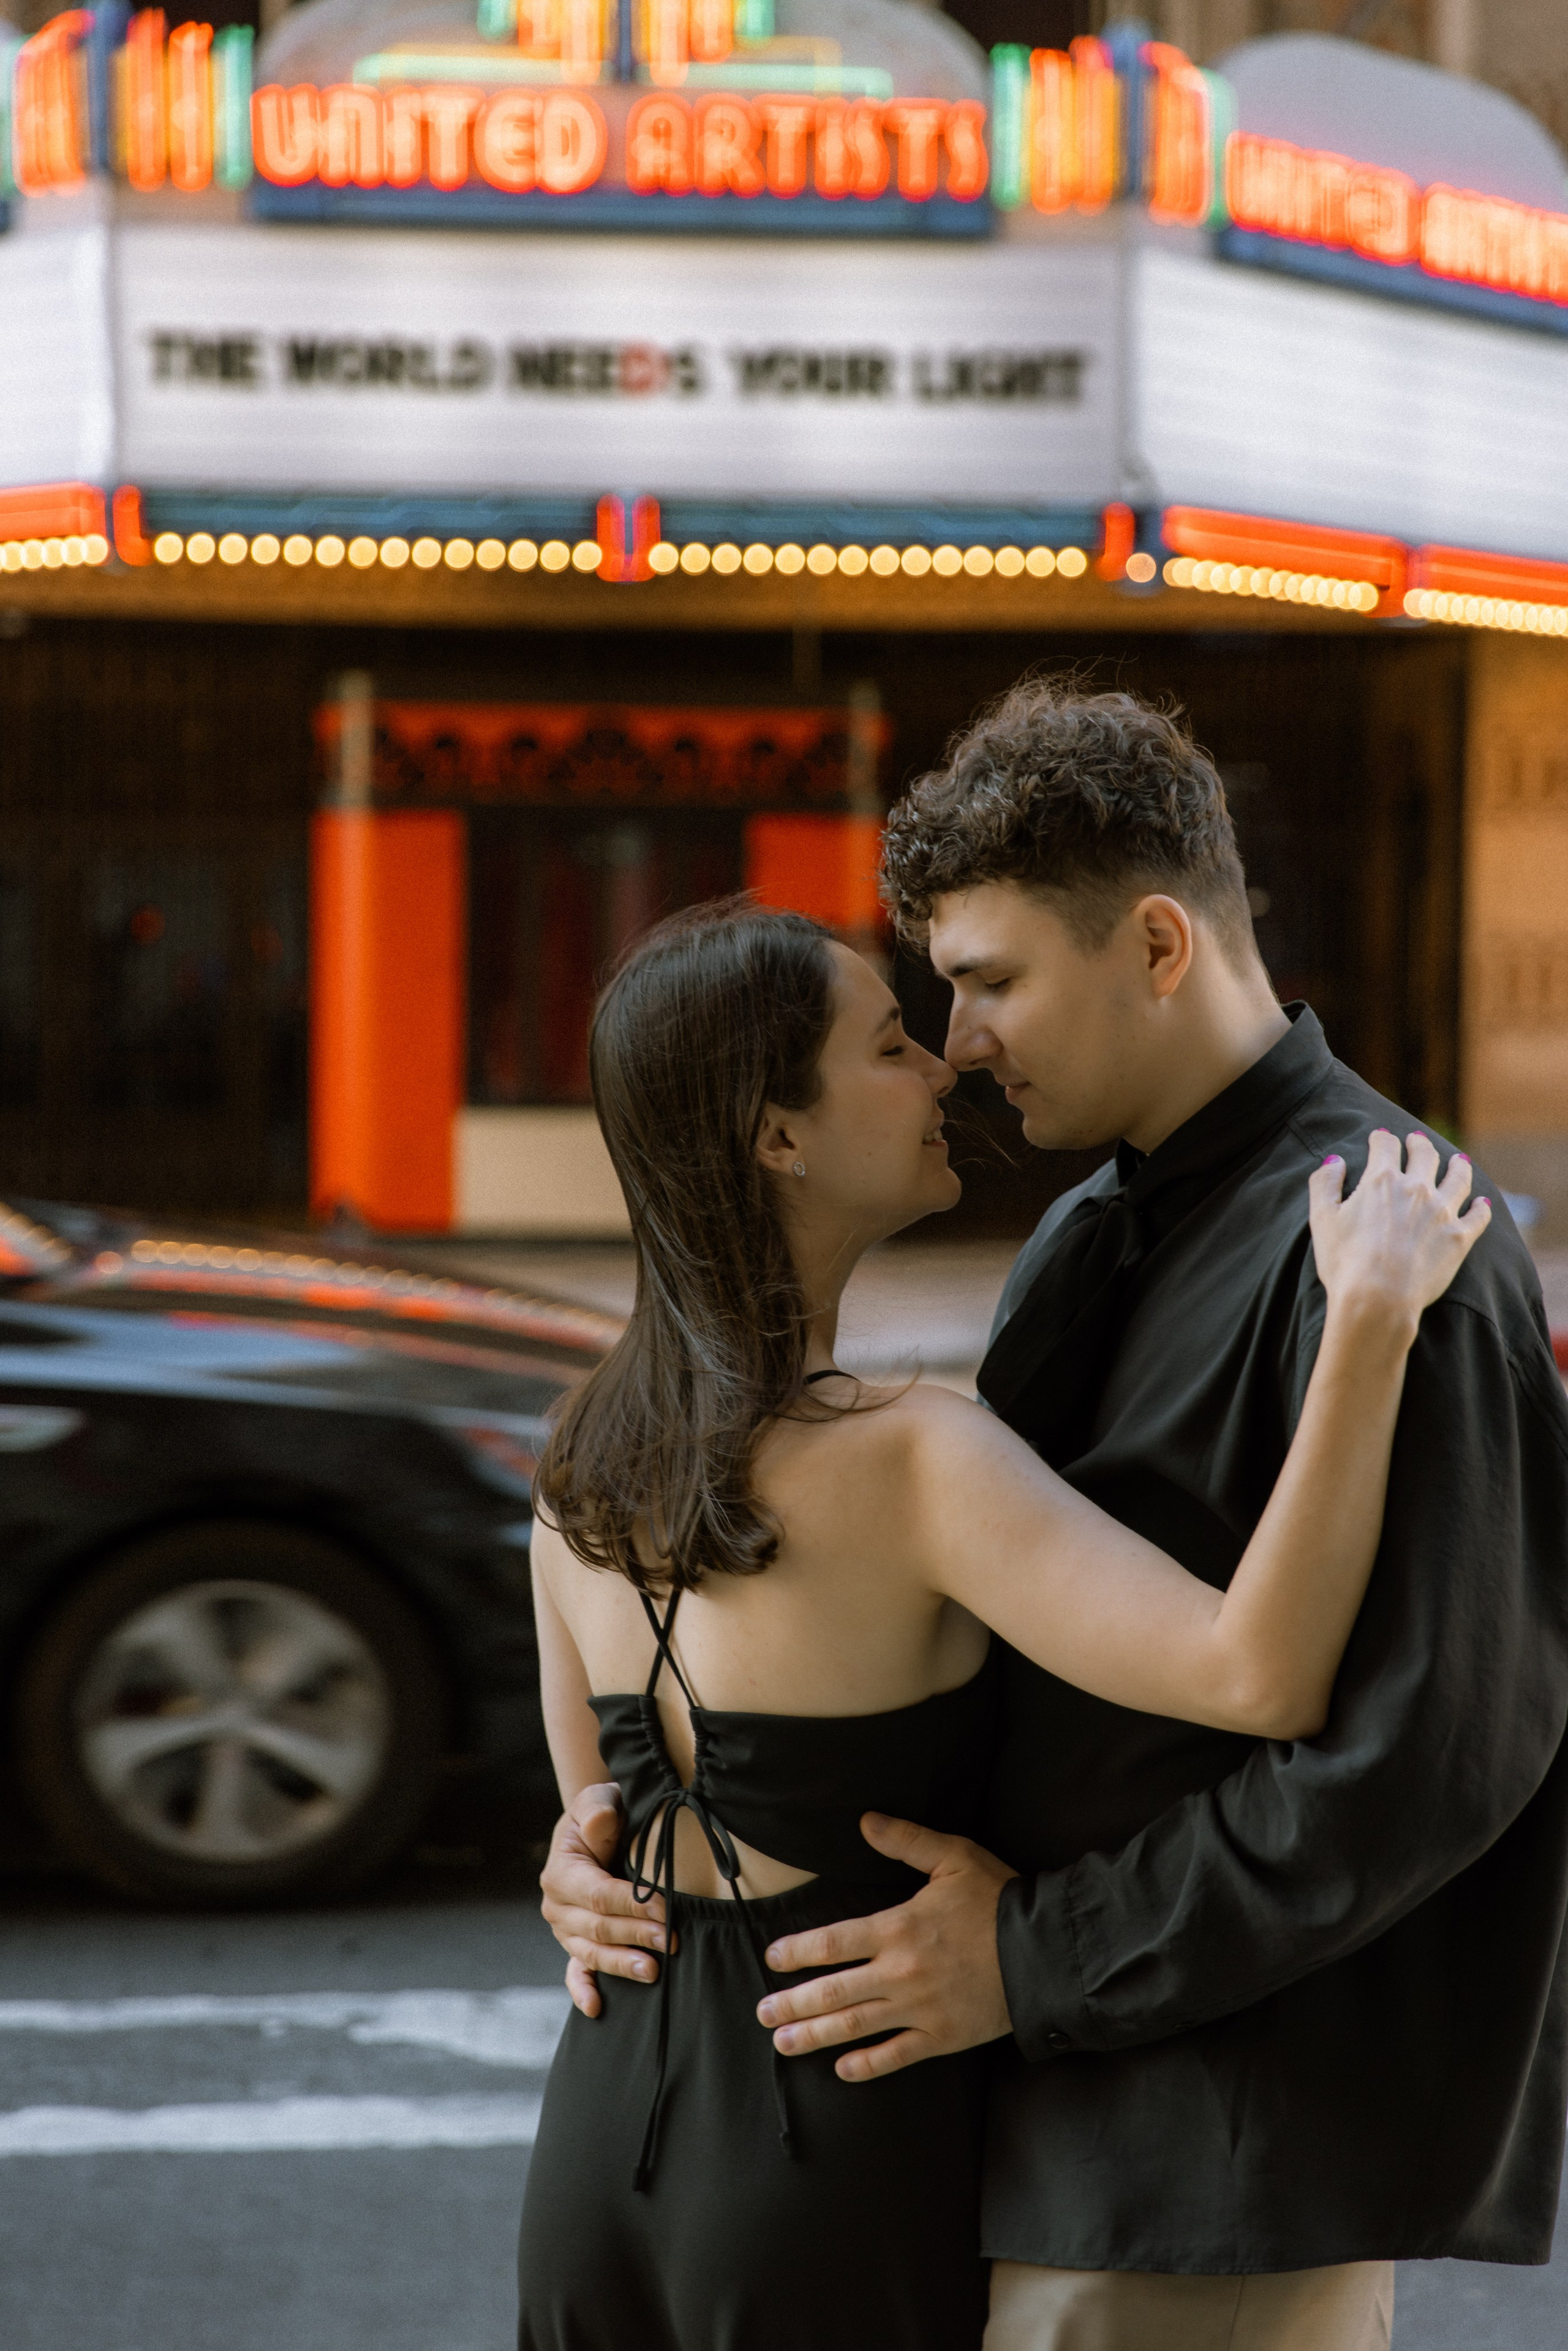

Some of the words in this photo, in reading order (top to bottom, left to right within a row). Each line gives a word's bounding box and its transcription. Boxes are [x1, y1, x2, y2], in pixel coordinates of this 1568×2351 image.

[250, 83, 608, 194] UNITED
[625, 92, 990, 202] ARTISTS
[151, 329, 257, 390] THE
[282, 333, 489, 396] WORLD
[508, 341, 703, 401] NEEDS
[730, 343, 897, 407] YOUR
[911, 345, 1085, 409] LIGHT
